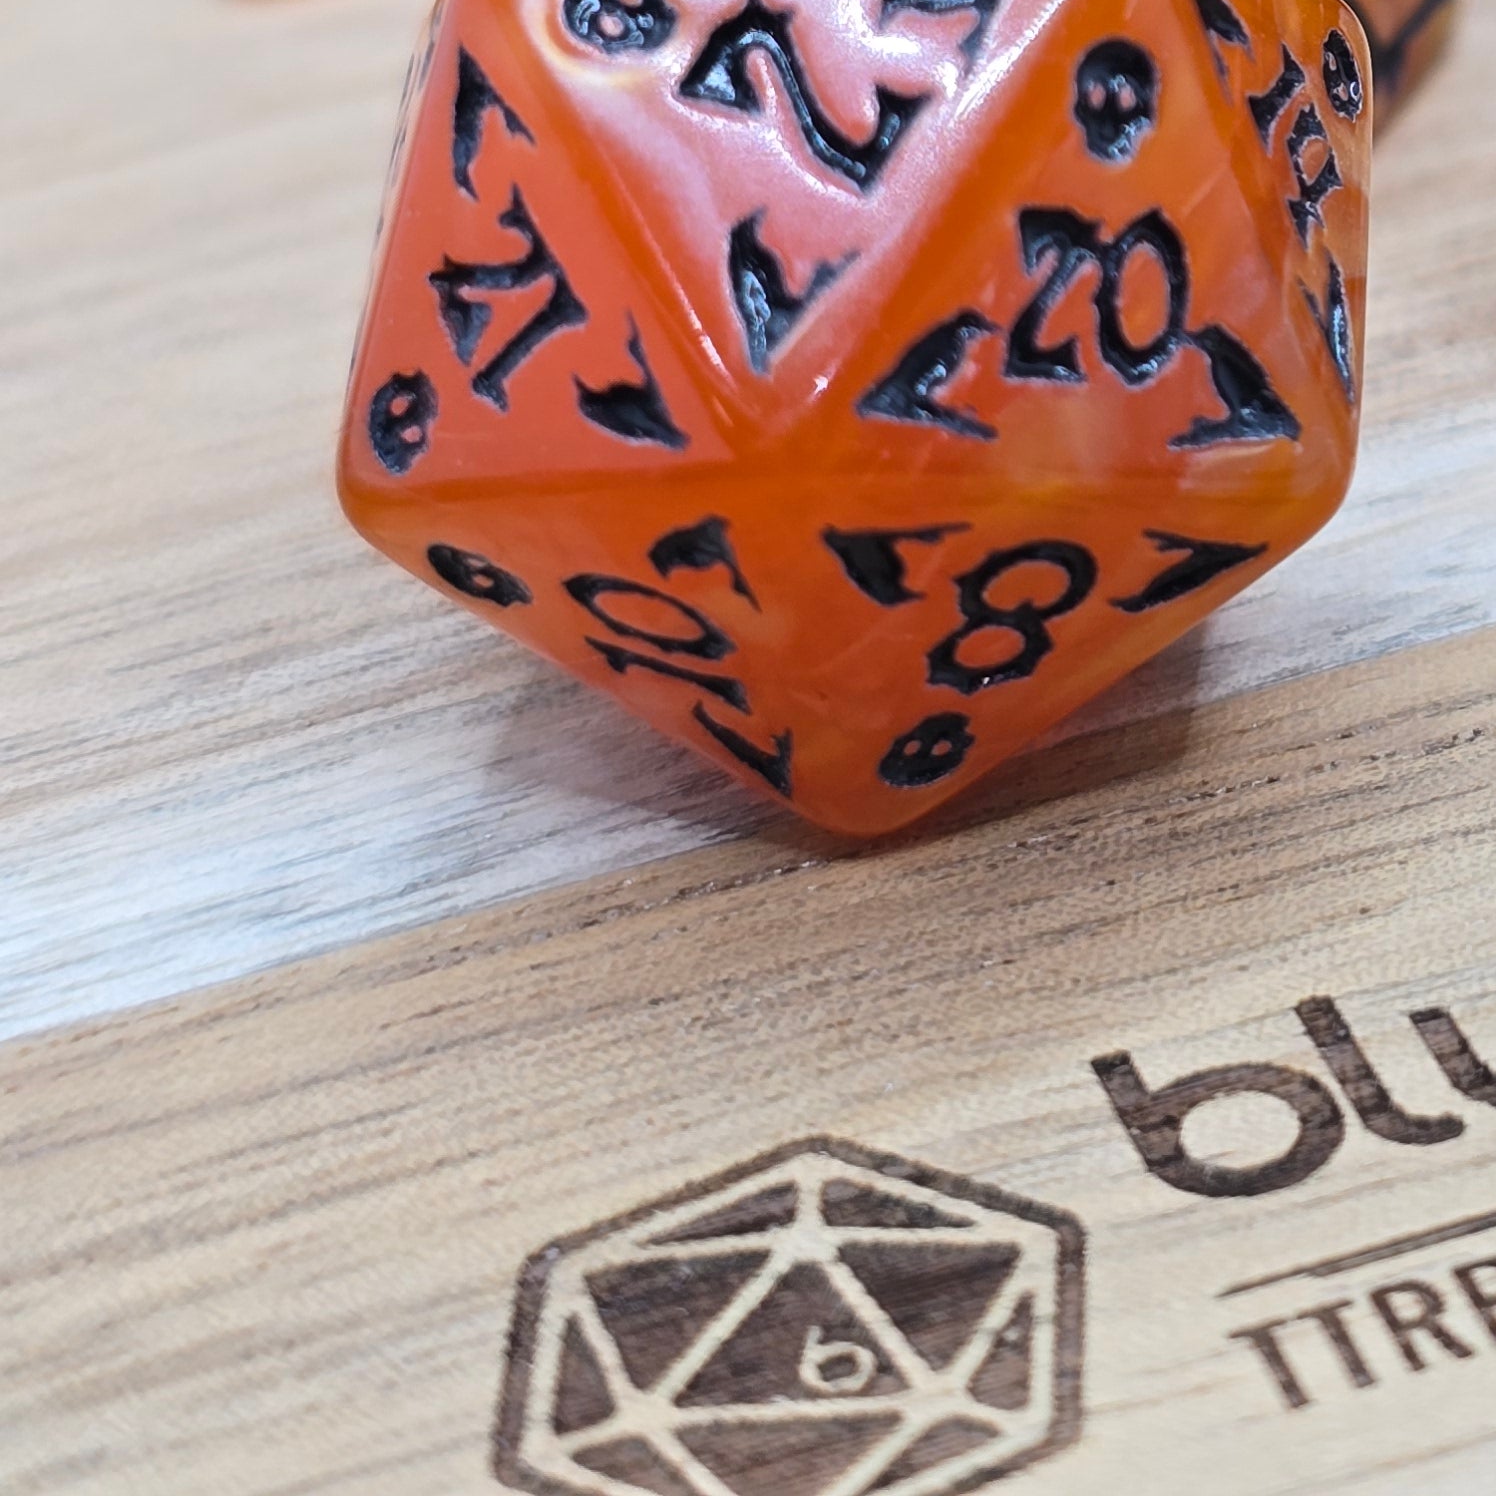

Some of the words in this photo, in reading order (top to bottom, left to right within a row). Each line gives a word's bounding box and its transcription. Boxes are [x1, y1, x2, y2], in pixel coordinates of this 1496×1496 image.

[1002, 204, 1190, 390] 20
[560, 572, 738, 716] 10
[924, 538, 1100, 696] 8
